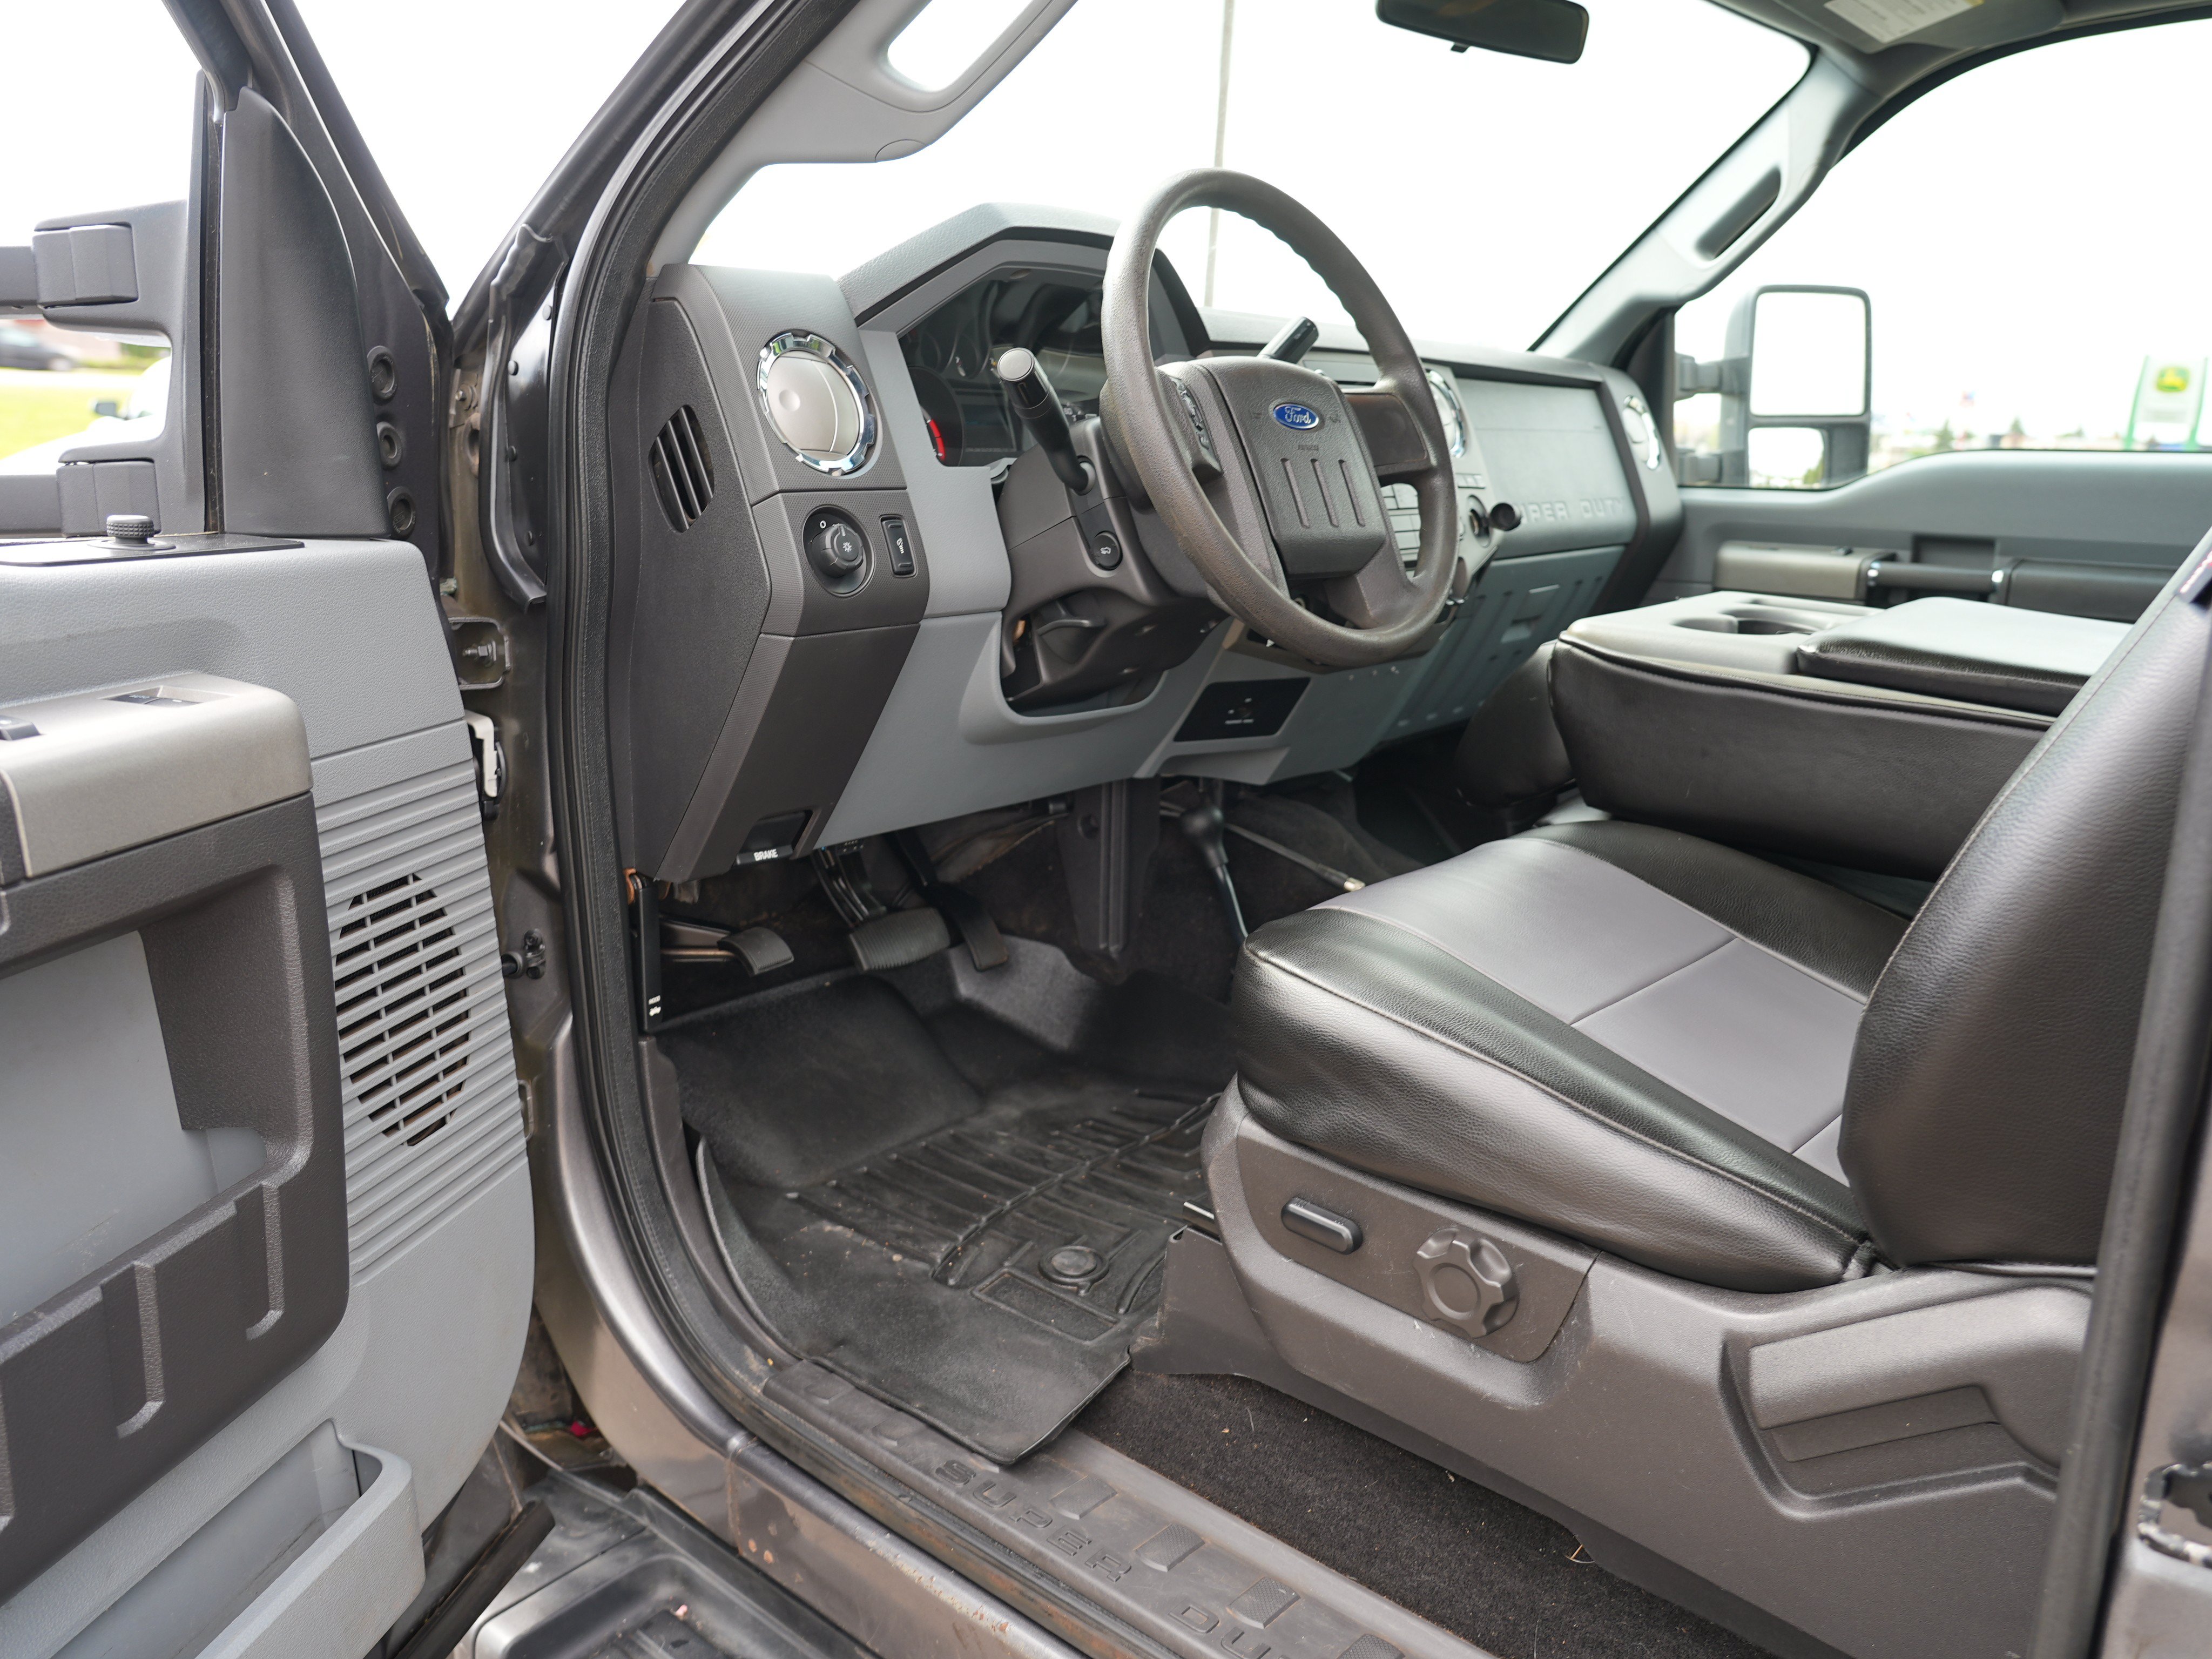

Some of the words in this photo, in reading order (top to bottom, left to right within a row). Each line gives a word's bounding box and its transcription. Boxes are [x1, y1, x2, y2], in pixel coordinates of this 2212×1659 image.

[1284, 406, 1311, 424] Ford
[753, 848, 778, 861] BRAKE
[934, 1459, 1132, 1582] SUPER
